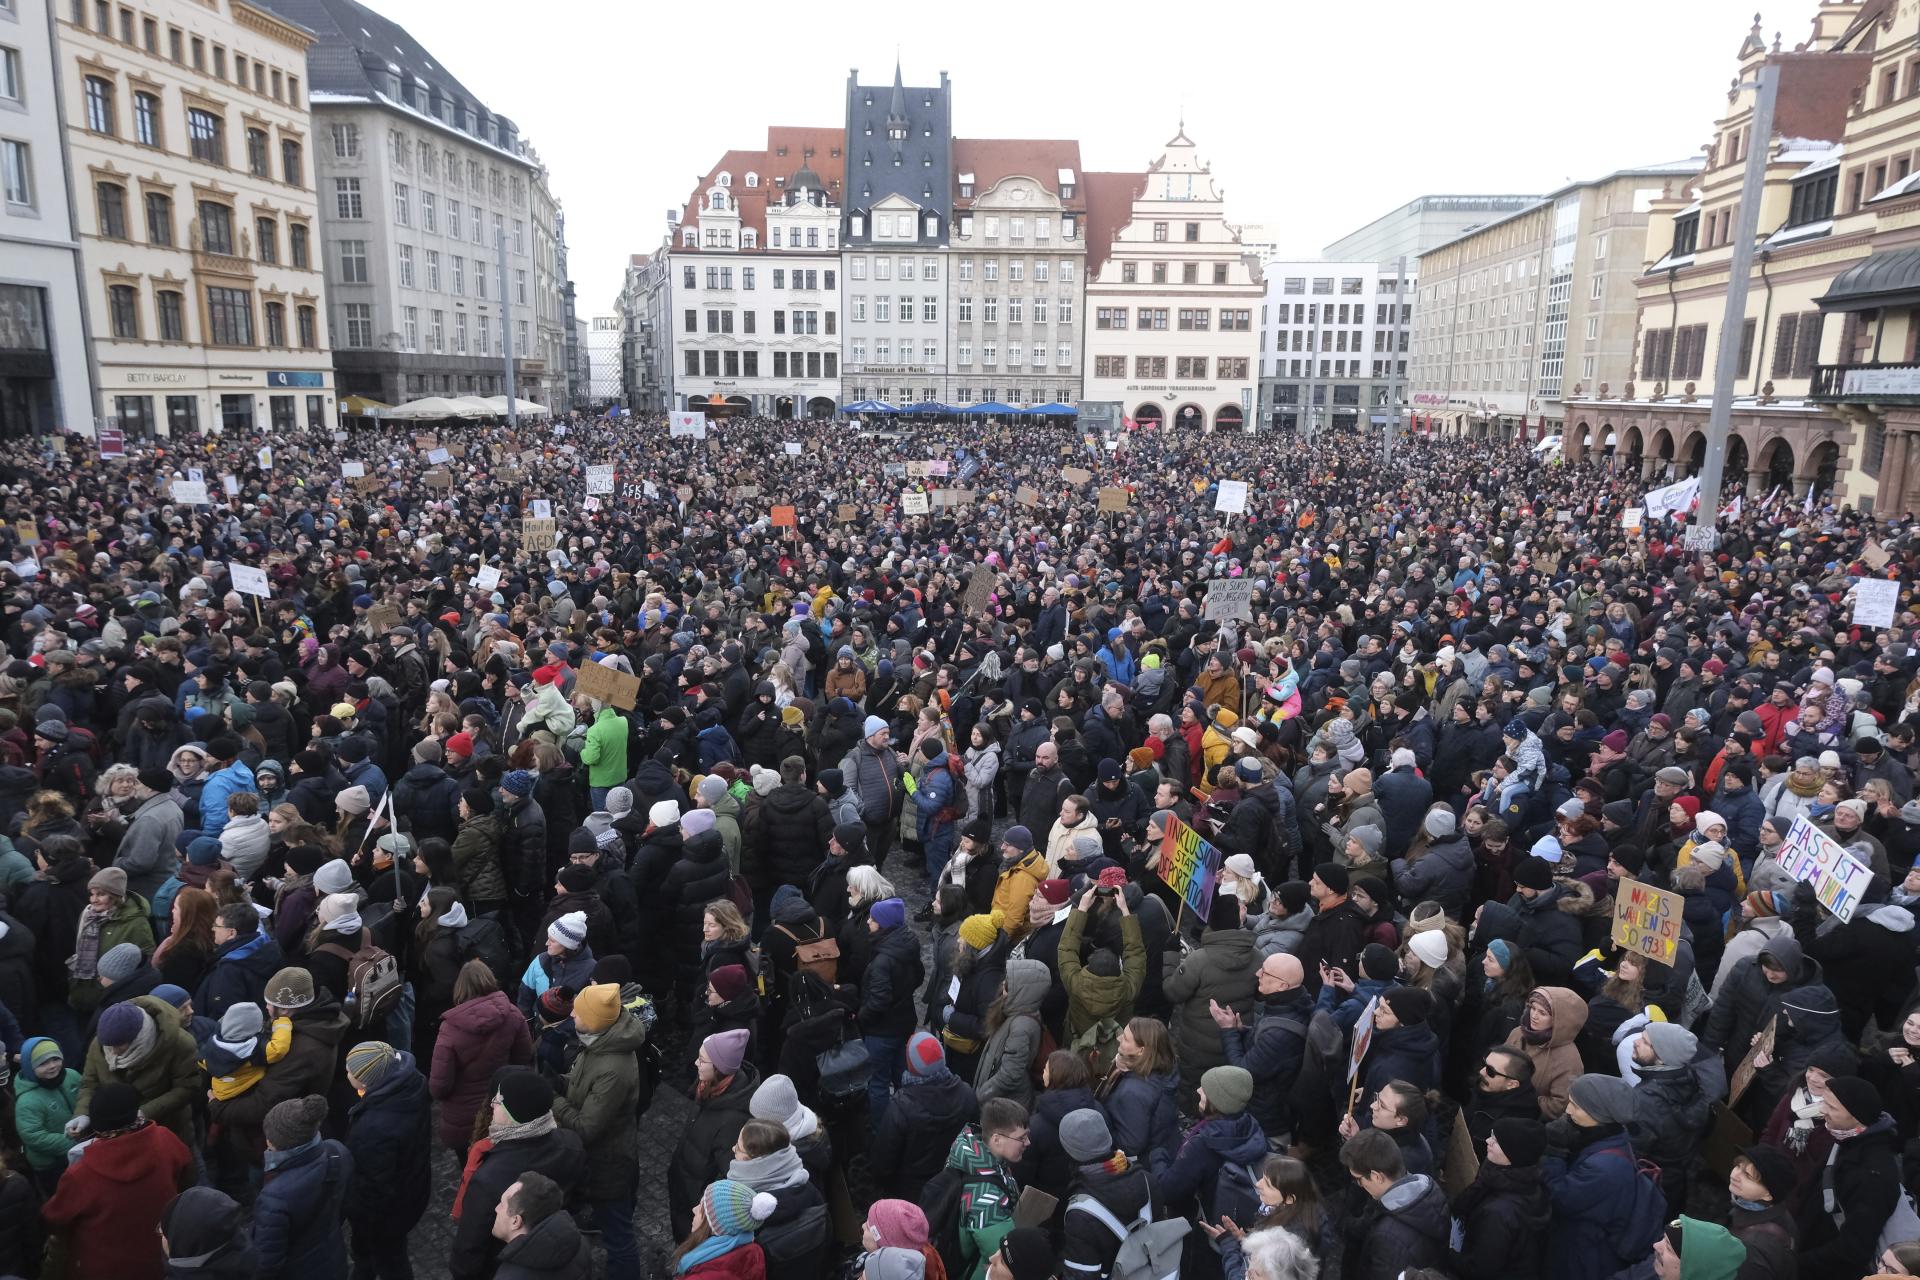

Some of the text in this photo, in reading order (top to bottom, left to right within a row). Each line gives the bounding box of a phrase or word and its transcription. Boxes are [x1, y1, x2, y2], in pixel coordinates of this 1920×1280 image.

[127, 373, 186, 383] BETTY BARCLAY
[587, 480, 614, 493] NAZIS
[623, 482, 642, 493] FCK
[1212, 580, 1248, 591] WIR SIND
[1168, 817, 1220, 875] INKLUSION
[1788, 817, 1864, 884] HASS IST
[1175, 850, 1199, 876] STATT
[1158, 853, 1209, 918] DEPORTATION
[1775, 842, 1856, 921] KEINE MEINUNG
[1631, 887, 1670, 917] NAZIS
[1618, 903, 1680, 940] WÄHLEN IST
[1618, 923, 1675, 960] SO 1933!
